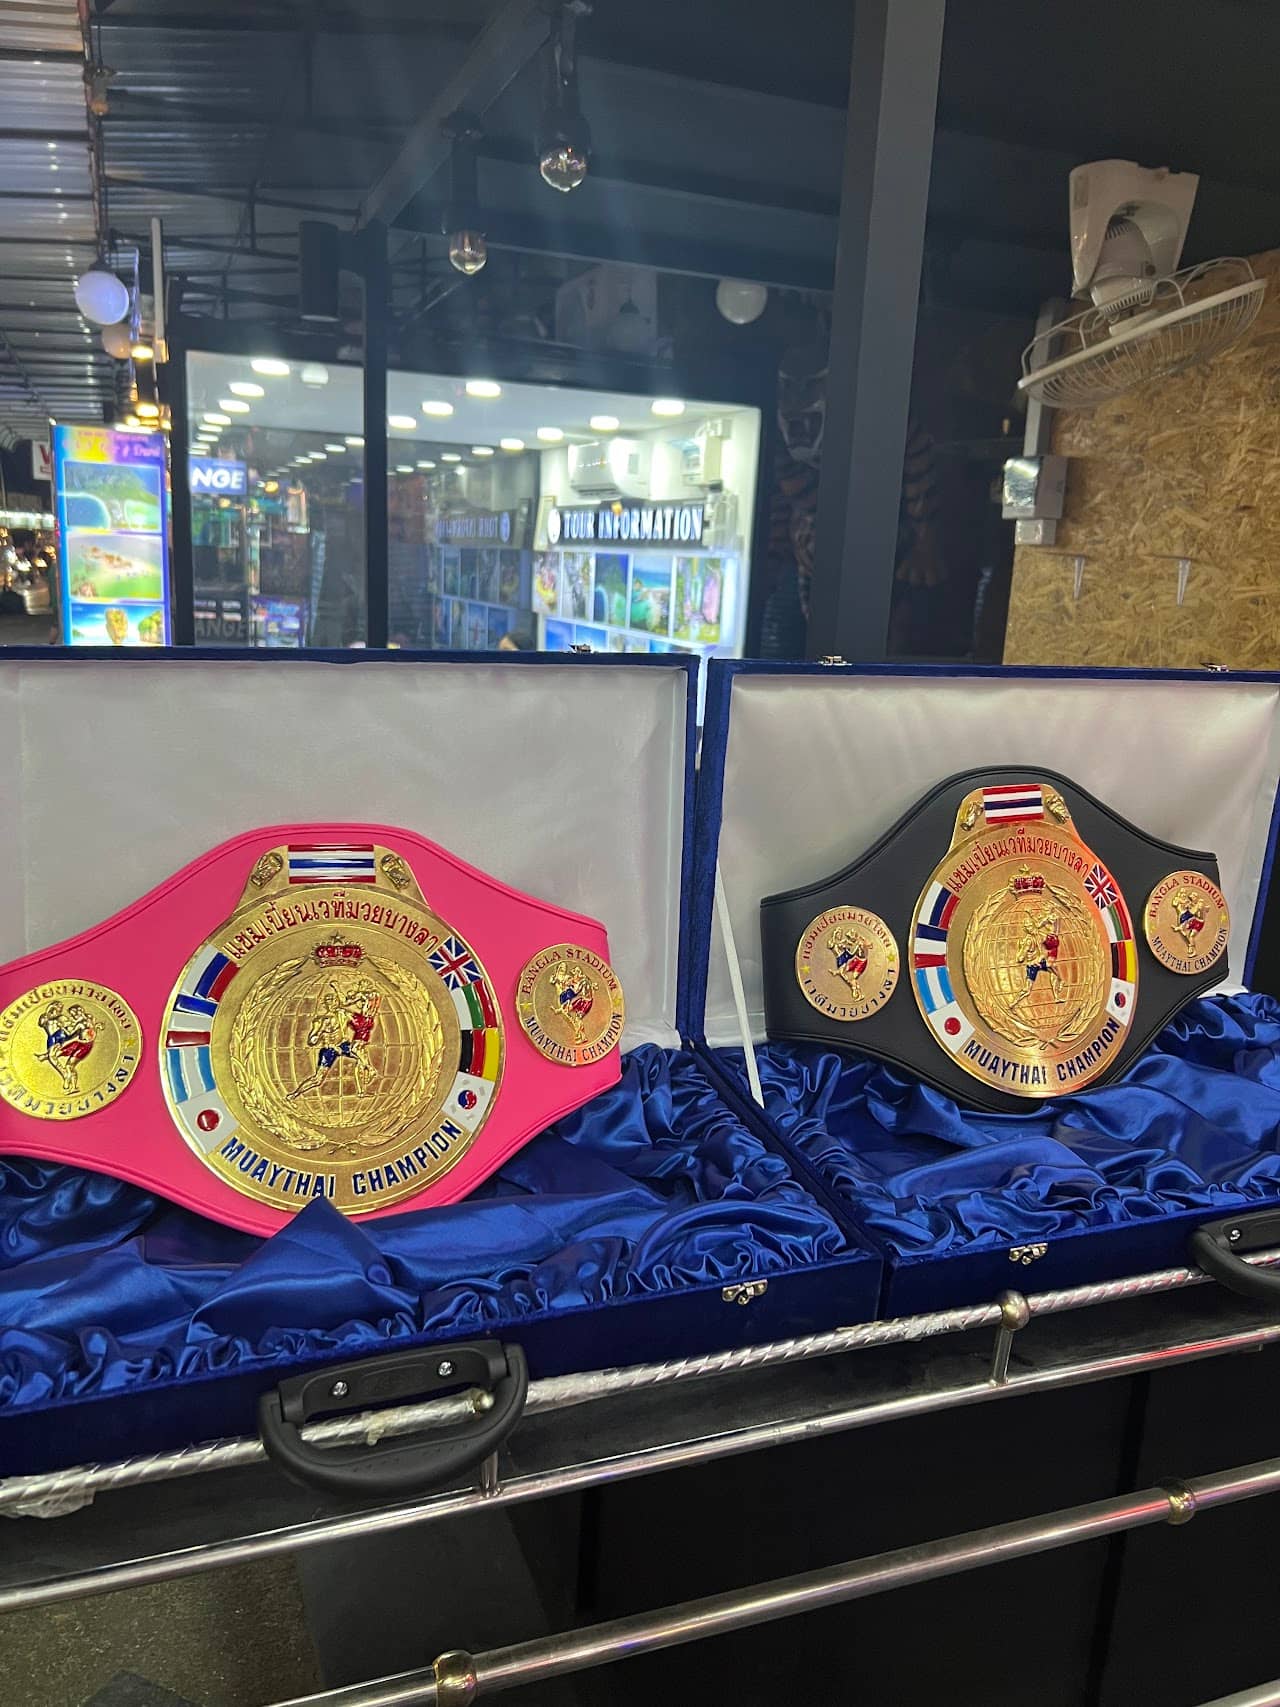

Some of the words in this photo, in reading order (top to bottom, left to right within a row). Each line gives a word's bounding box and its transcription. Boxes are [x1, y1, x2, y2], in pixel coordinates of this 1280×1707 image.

[563, 510, 595, 539] TOUR
[598, 506, 704, 540] INFORMATION
[1183, 875, 1225, 909] STADIUM
[522, 951, 562, 995] BANGLA
[566, 948, 618, 991] STADIUM
[1152, 936, 1191, 972] MUAYTHAI
[1194, 928, 1228, 970] CHAMPION
[526, 1016, 577, 1062] MUAYTHAI
[582, 1012, 623, 1061] CHAMPION
[963, 1039, 1048, 1085] MUAYTHAI
[1056, 1017, 1122, 1082] CHAMPION
[220, 1136, 336, 1199] MUAYTHAI
[351, 1118, 463, 1196] CHAMPION
